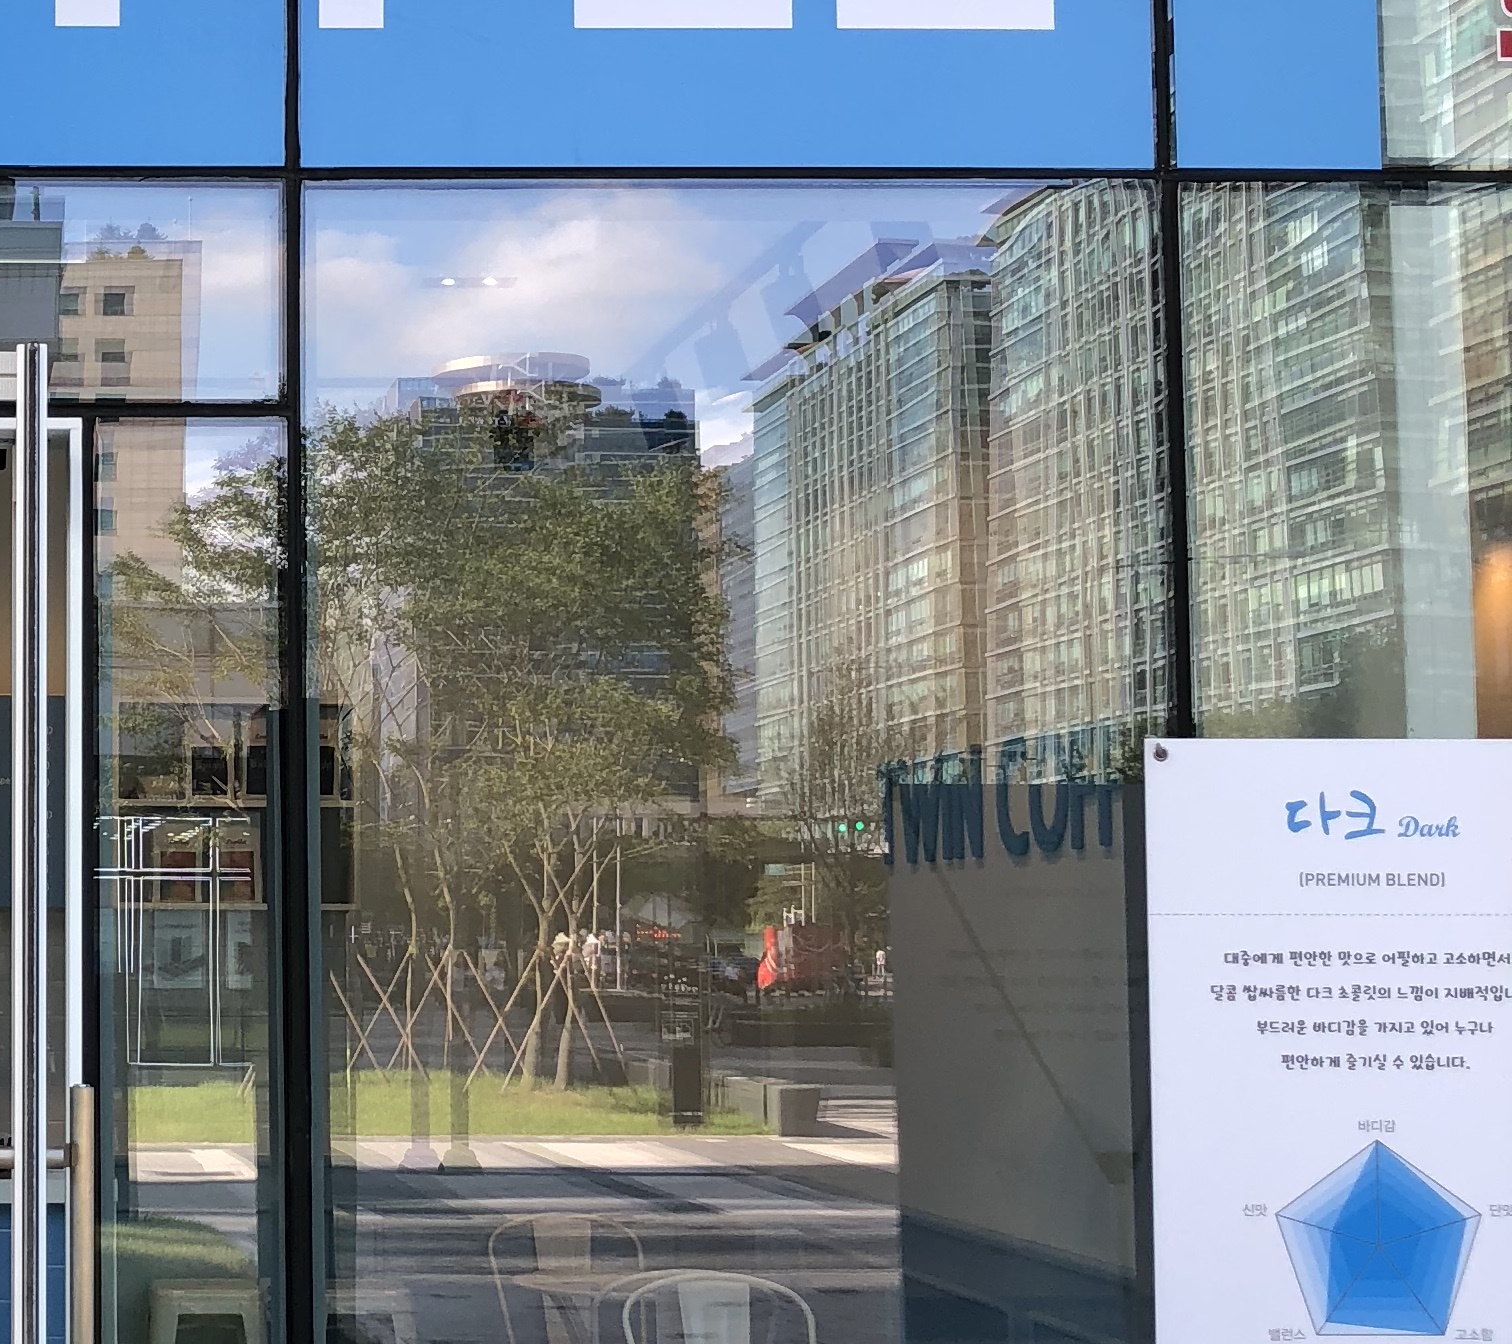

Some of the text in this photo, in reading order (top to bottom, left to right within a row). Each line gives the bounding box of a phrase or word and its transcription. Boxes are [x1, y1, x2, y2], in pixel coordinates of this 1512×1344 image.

[1284, 789, 1461, 841] 다크 Dark
[1223, 950, 1284, 967] 대중에게
[1288, 950, 1333, 968] 편안한
[1337, 950, 1377, 967] 맛으로
[1381, 950, 1439, 968] 어필하고
[1210, 984, 1237, 1002] 달콤
[1306, 986, 1334, 999] 다크
[1338, 983, 1392, 1003] 초콜릿의
[1396, 985, 1439, 1002] 느낌이
[1256, 1018, 1494, 1037] 부드러운 바디감을 가지고 있어 누구나
[1280, 1052, 1471, 1071] 편안하게 즐기실 수 있습니다.
[1357, 1119, 1397, 1134] 바디감
[1241, 1203, 1268, 1218] 신맛
[1268, 1327, 1307, 1342] 밸런스
[1454, 1327, 1494, 1342] 고소함
